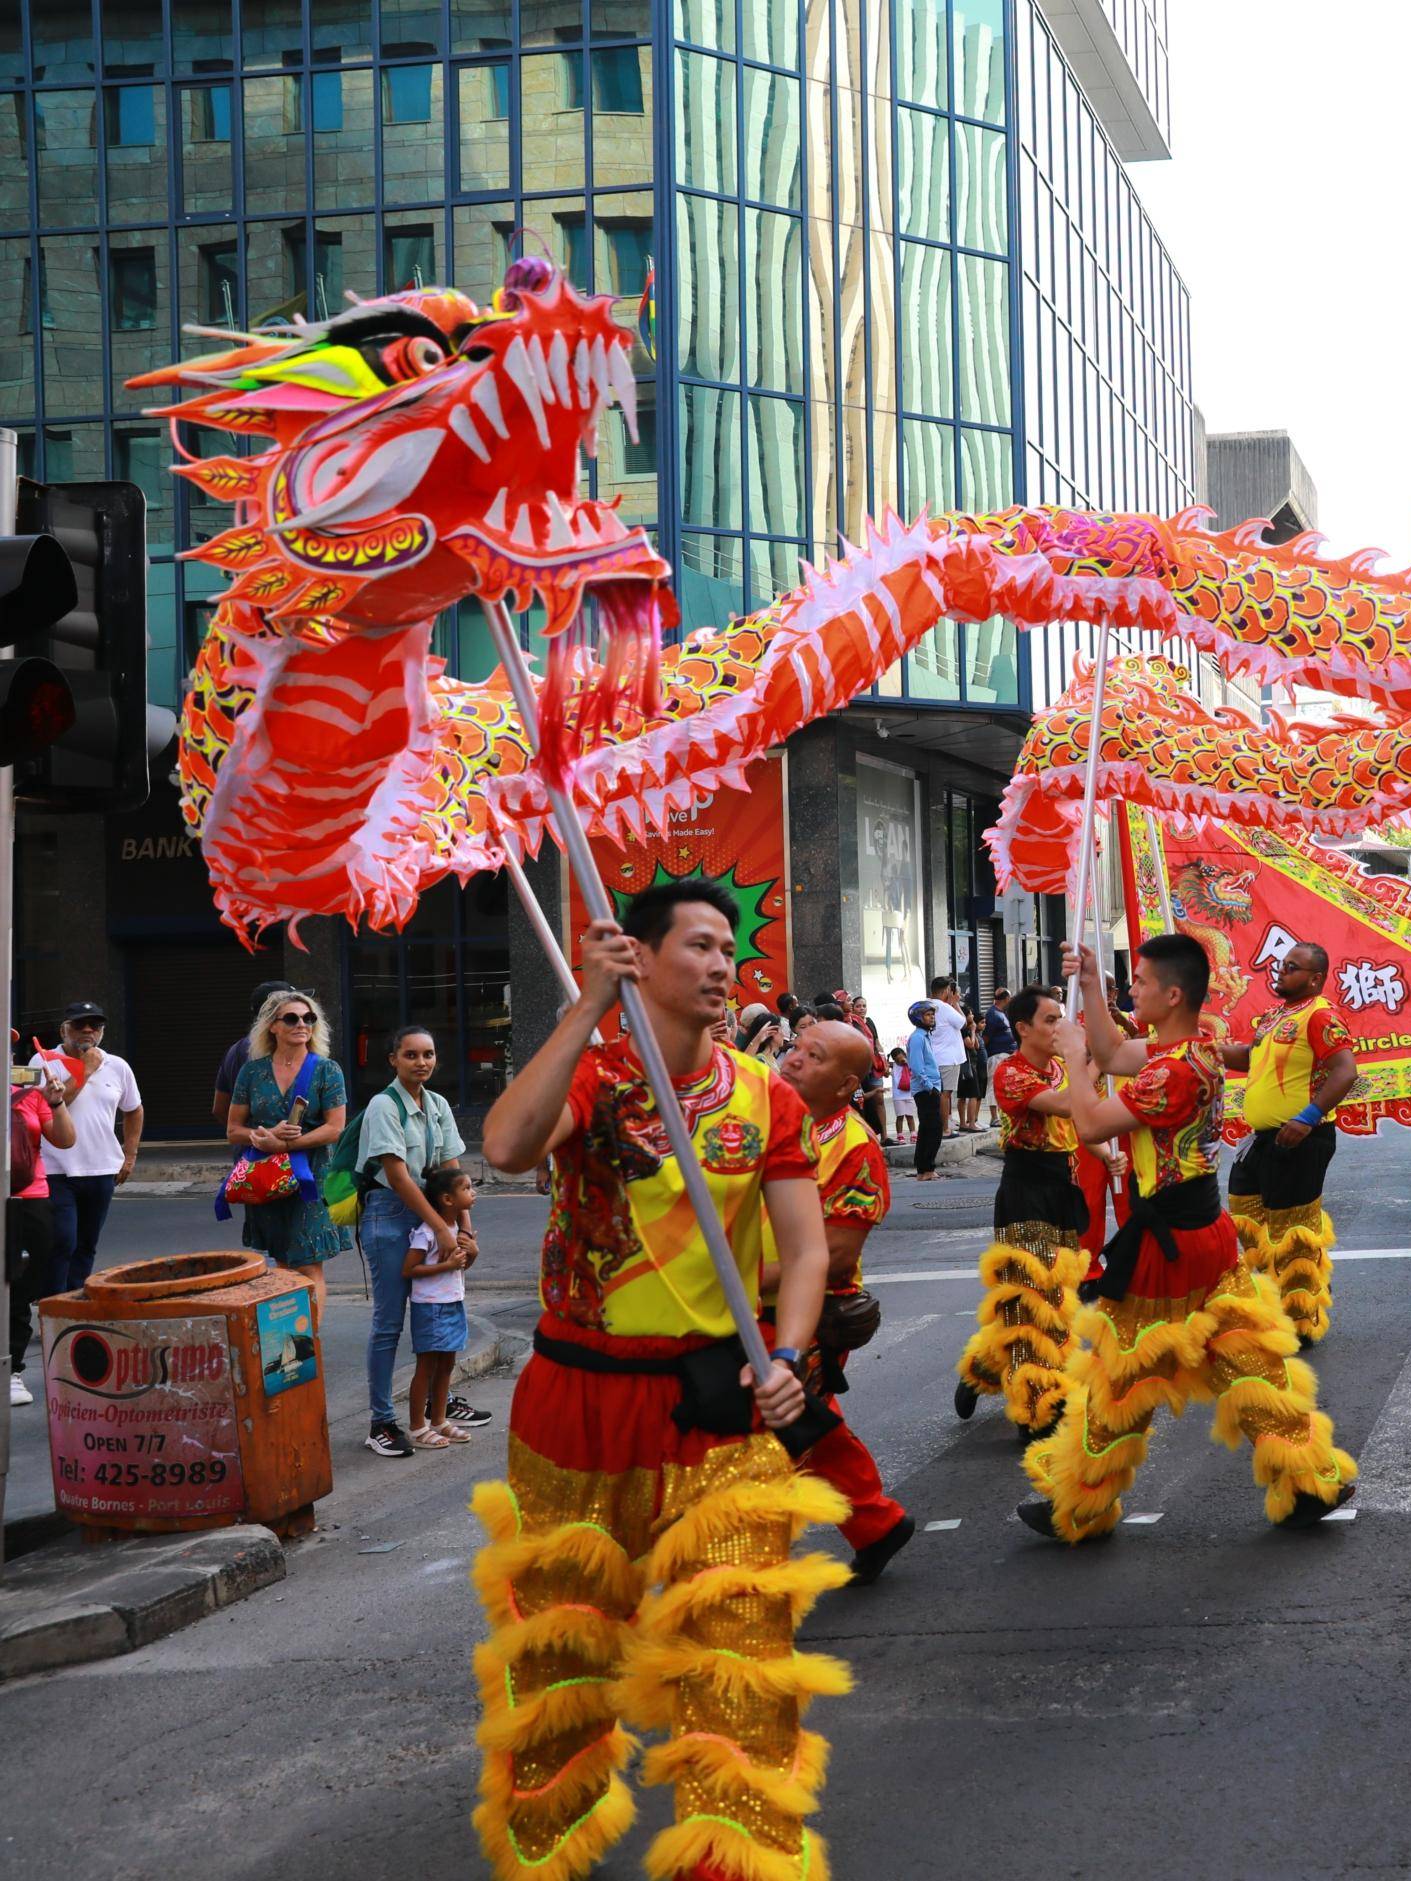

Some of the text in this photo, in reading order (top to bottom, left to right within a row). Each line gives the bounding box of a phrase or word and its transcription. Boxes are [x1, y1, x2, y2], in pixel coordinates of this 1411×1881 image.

[673, 829, 693, 838] Made
[694, 828, 715, 838] Easy!
[121, 836, 193, 860] BANK
[133, 1434, 167, 1455] 7/7
[57, 1456, 227, 1488] Tel: 425-8989
[60, 1489, 89, 1509] Quatre
[91, 1496, 136, 1512] Bornes
